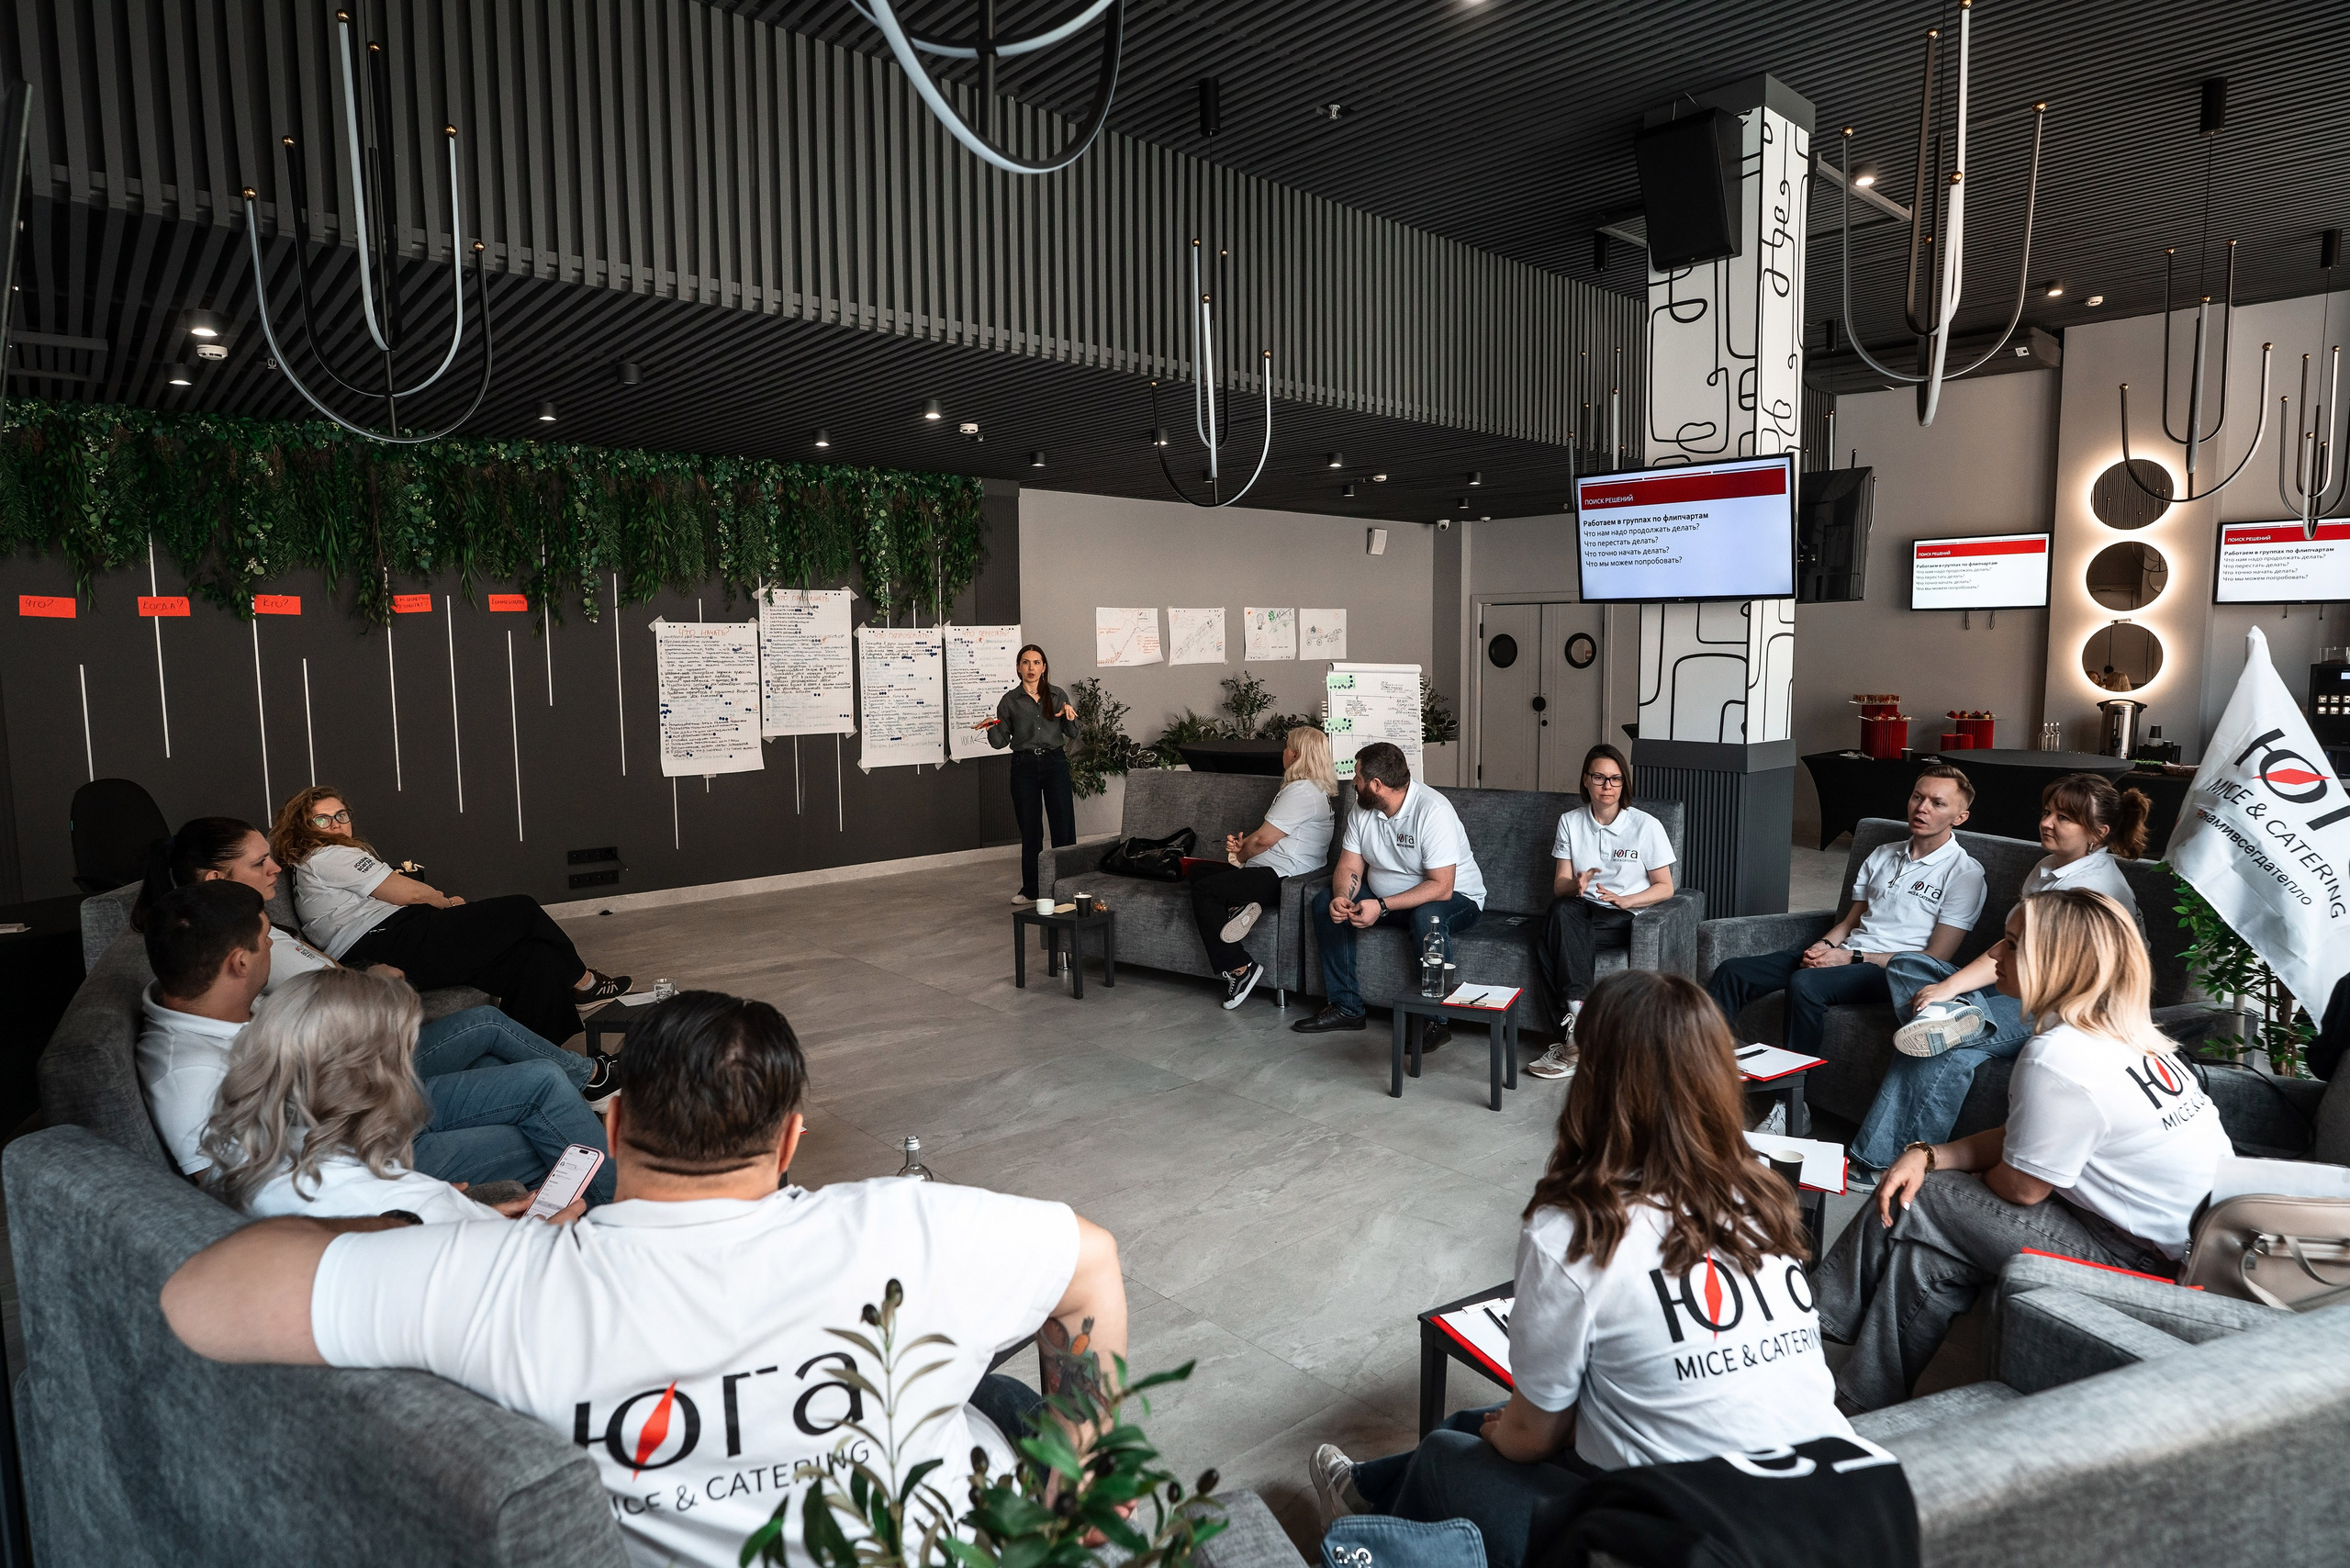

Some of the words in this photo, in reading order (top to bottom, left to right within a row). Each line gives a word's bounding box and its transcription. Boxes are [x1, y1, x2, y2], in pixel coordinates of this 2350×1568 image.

[1605, 495, 1633, 503] РЕШЕНИЙ
[1623, 517, 1651, 526] группах
[1663, 513, 1709, 523] флипчартам
[1629, 526, 1670, 536] продолжать
[1671, 523, 1699, 533] делать?
[1598, 539, 1630, 548] перестать
[1632, 536, 1658, 545] делать?
[1643, 546, 1669, 555] делать?
[1634, 556, 1682, 566] попробовать?
[679, 628, 696, 636] ЧТО
[2206, 778, 2255, 805] MICE
[2245, 802, 2267, 820] &
[2266, 820, 2346, 919] CATERING
[2197, 809, 2312, 906] #намивсегдатепло
[1673, 1348, 1739, 1382] MICE
[1742, 1344, 1759, 1367] &
[1760, 1327, 1822, 1362] CATERIN
[611, 1491, 661, 1521] ICE
[676, 1484, 699, 1512] &
[706, 1439, 870, 1501] CATERING
